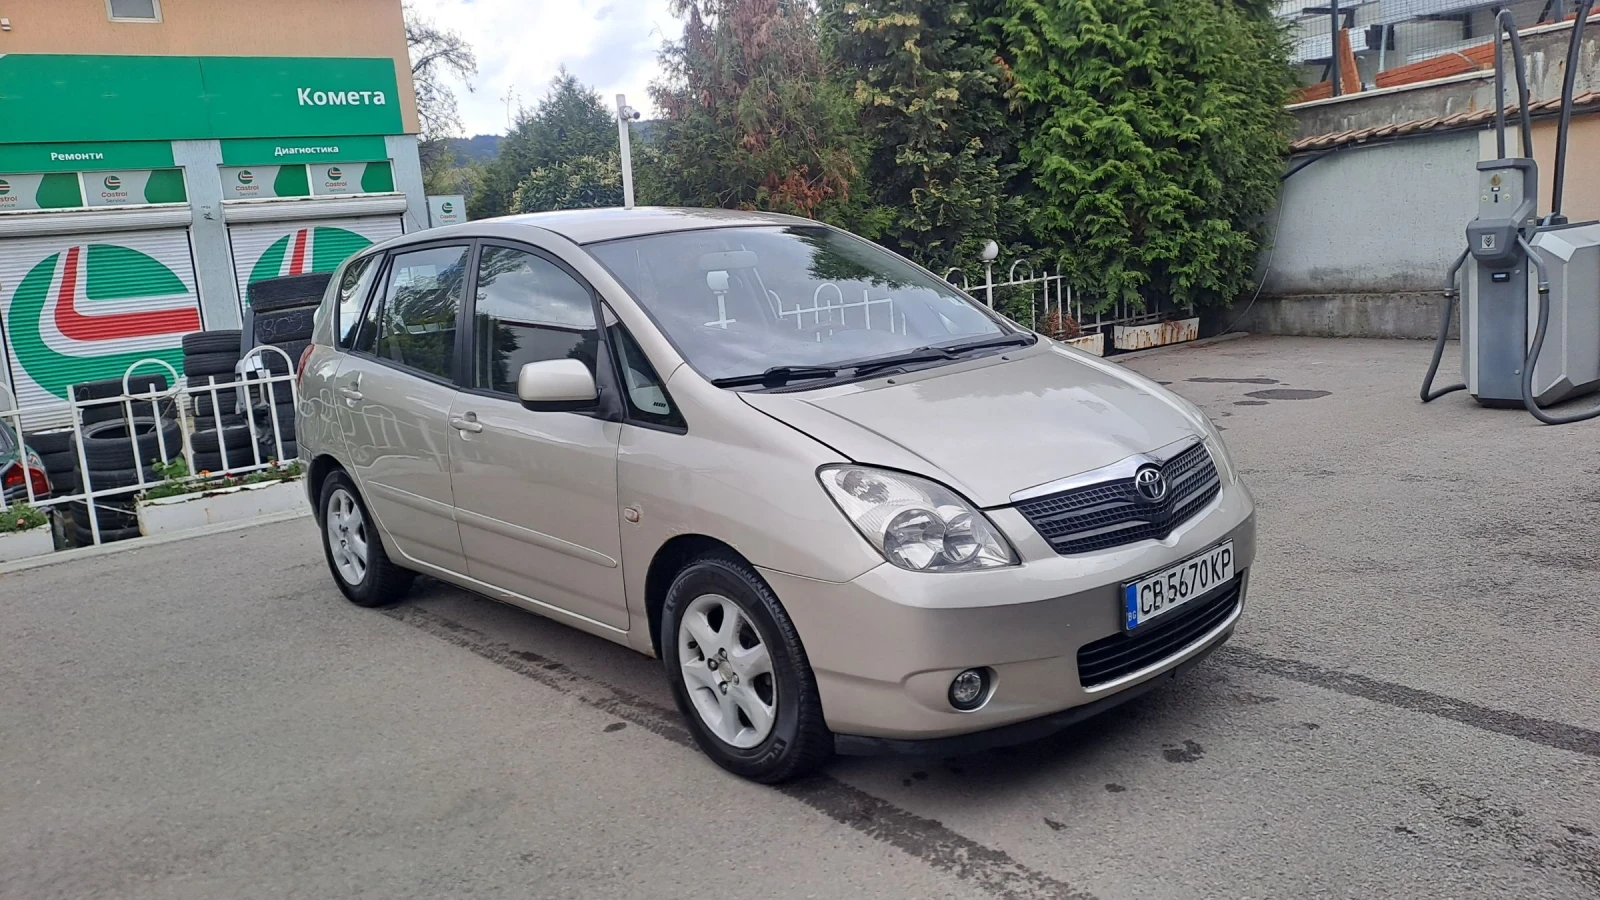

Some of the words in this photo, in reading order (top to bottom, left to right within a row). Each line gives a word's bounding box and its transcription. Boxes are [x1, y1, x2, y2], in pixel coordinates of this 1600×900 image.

[297, 87, 386, 106] Комета
[50, 151, 104, 161] Ремонти
[274, 145, 339, 156] Диагностика
[1127, 611, 1137, 622] BG
